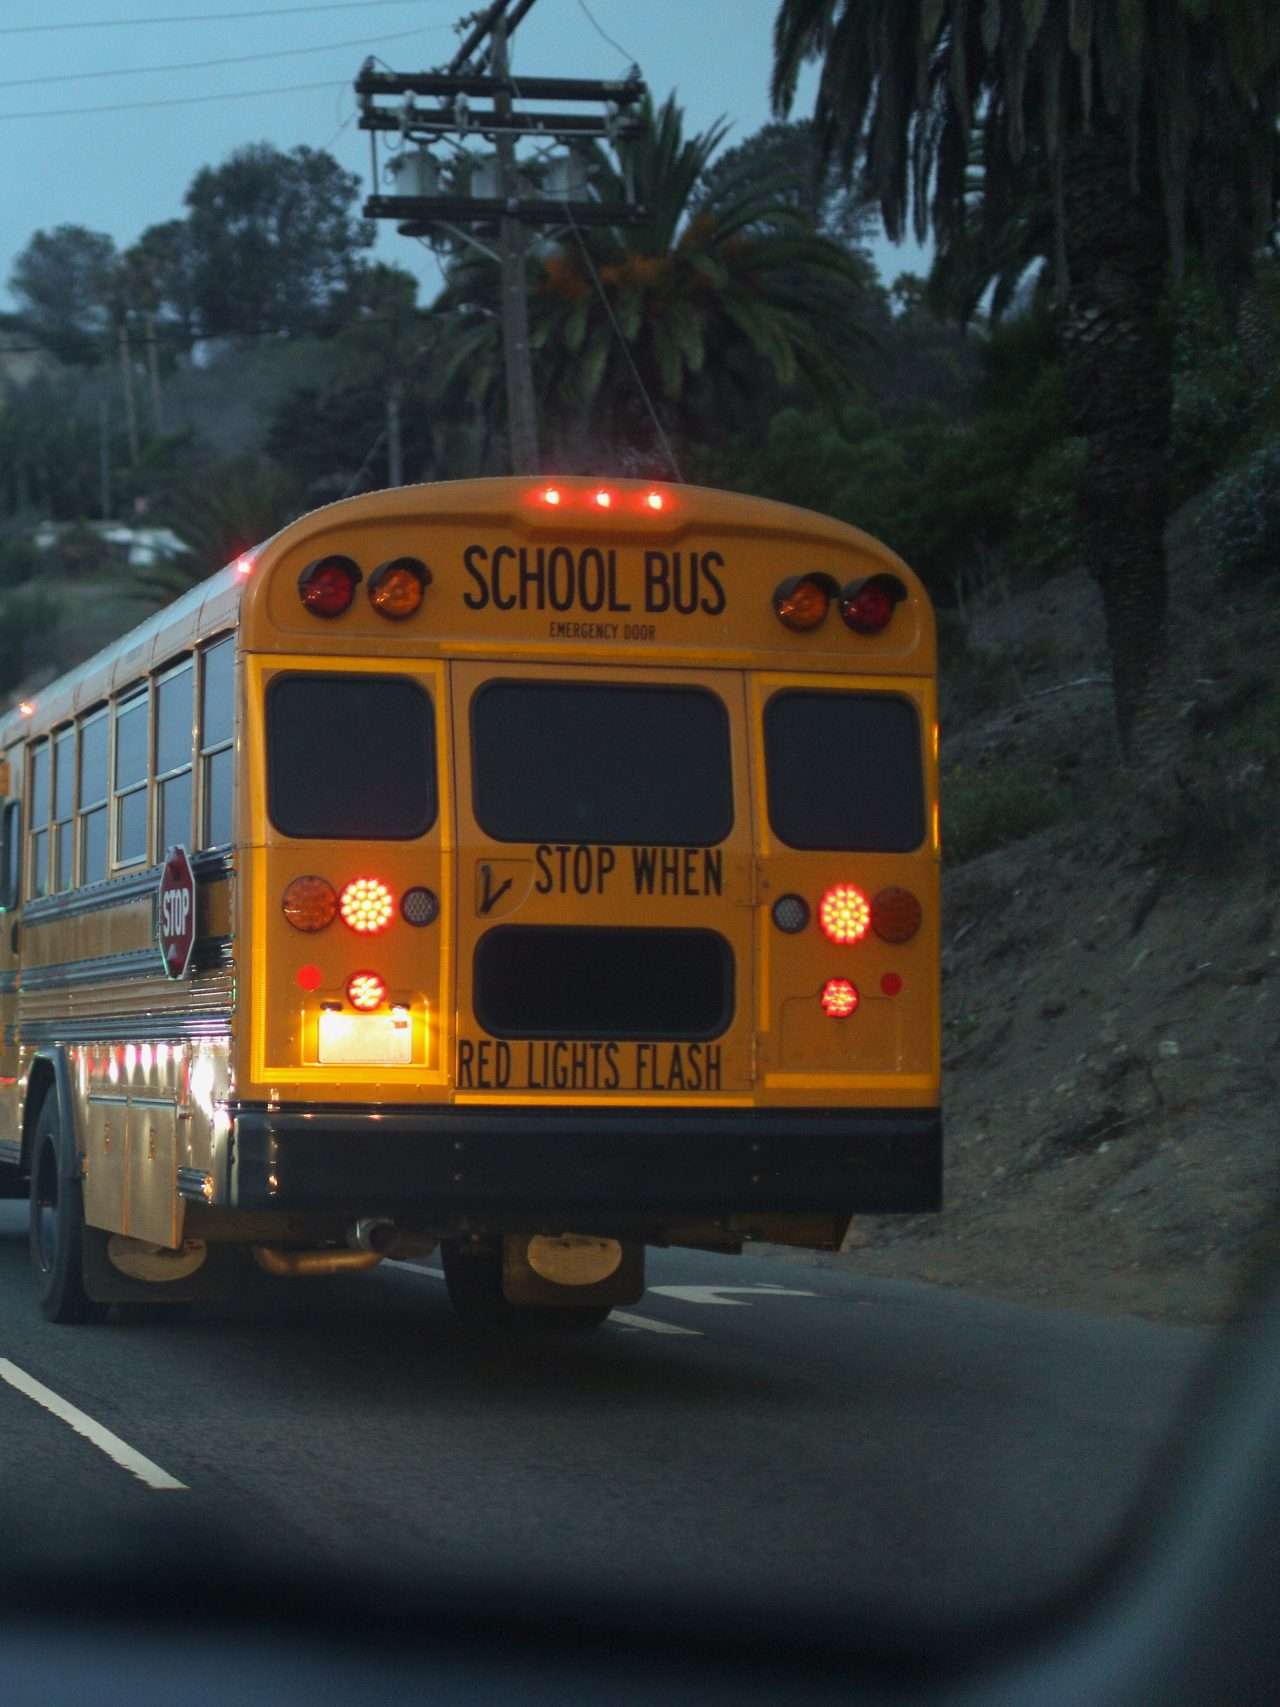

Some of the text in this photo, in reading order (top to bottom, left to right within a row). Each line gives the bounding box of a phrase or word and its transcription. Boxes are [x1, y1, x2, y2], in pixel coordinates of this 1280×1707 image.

[463, 545, 726, 615] SCHOOL BUS
[549, 621, 656, 641] EMERGENCY DOOR
[535, 844, 723, 897] STOP WHEN
[163, 888, 189, 937] STOP
[458, 1039, 721, 1090] RED LIGHTS FLASH
